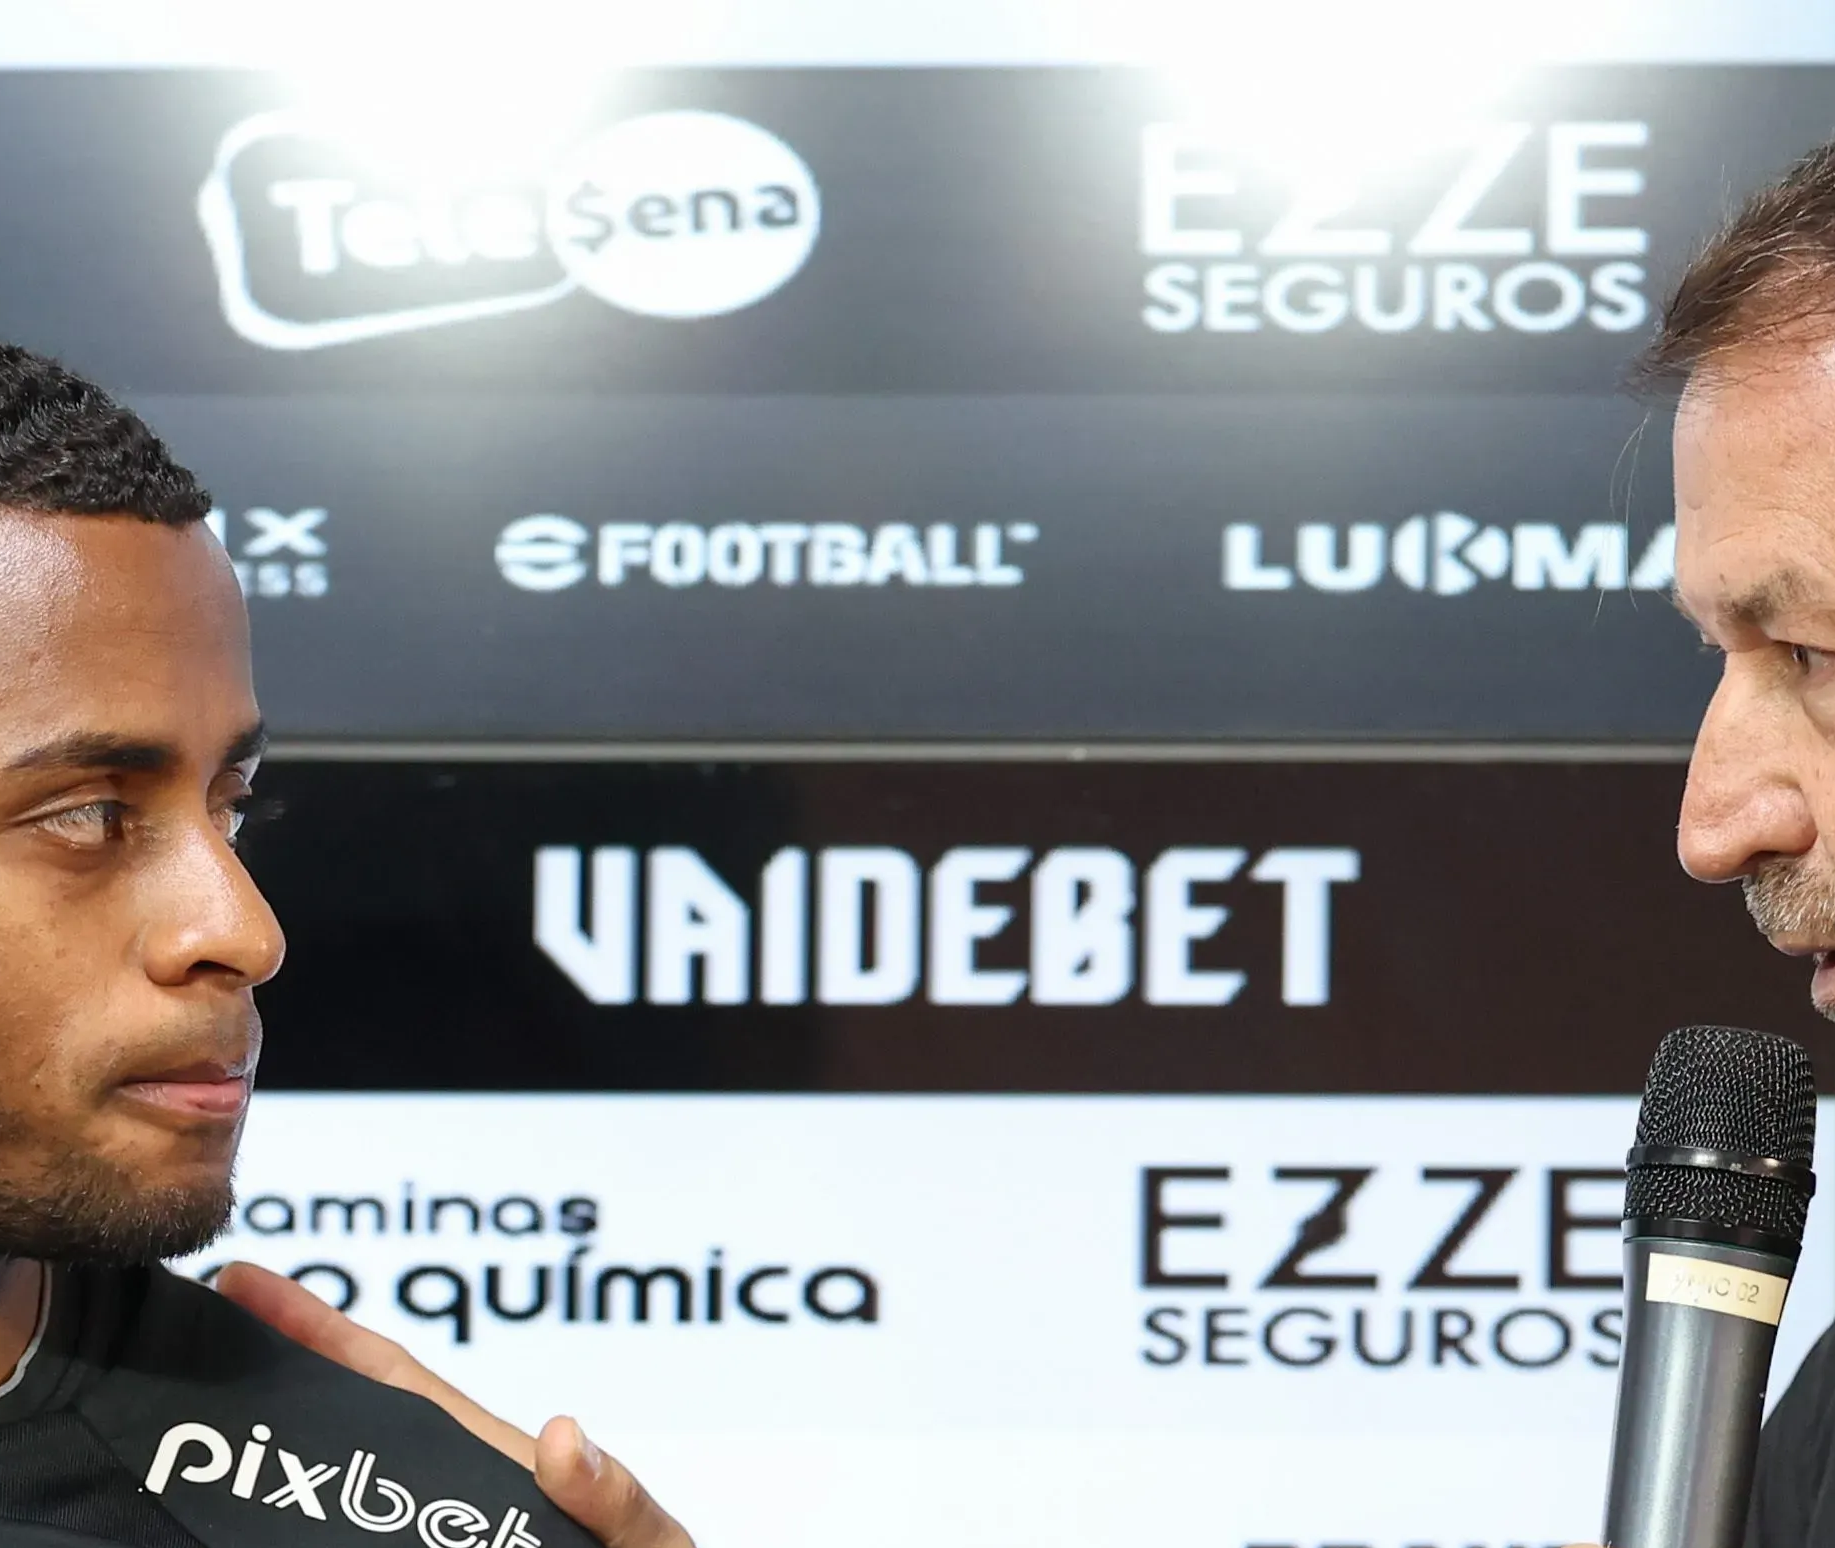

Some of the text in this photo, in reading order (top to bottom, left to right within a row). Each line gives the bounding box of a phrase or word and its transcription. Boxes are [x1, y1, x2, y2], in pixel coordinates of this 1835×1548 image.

[1139, 122, 1647, 256] EZZE
[1142, 263, 1647, 332] SEGUROS
[534, 846, 1360, 1006] VAIDEBET
[244, 1181, 599, 1235] aminas
[1140, 1166, 1623, 1290] EZZE
[395, 1246, 878, 1342] química
[1141, 1306, 1623, 1366] SEGUROS
